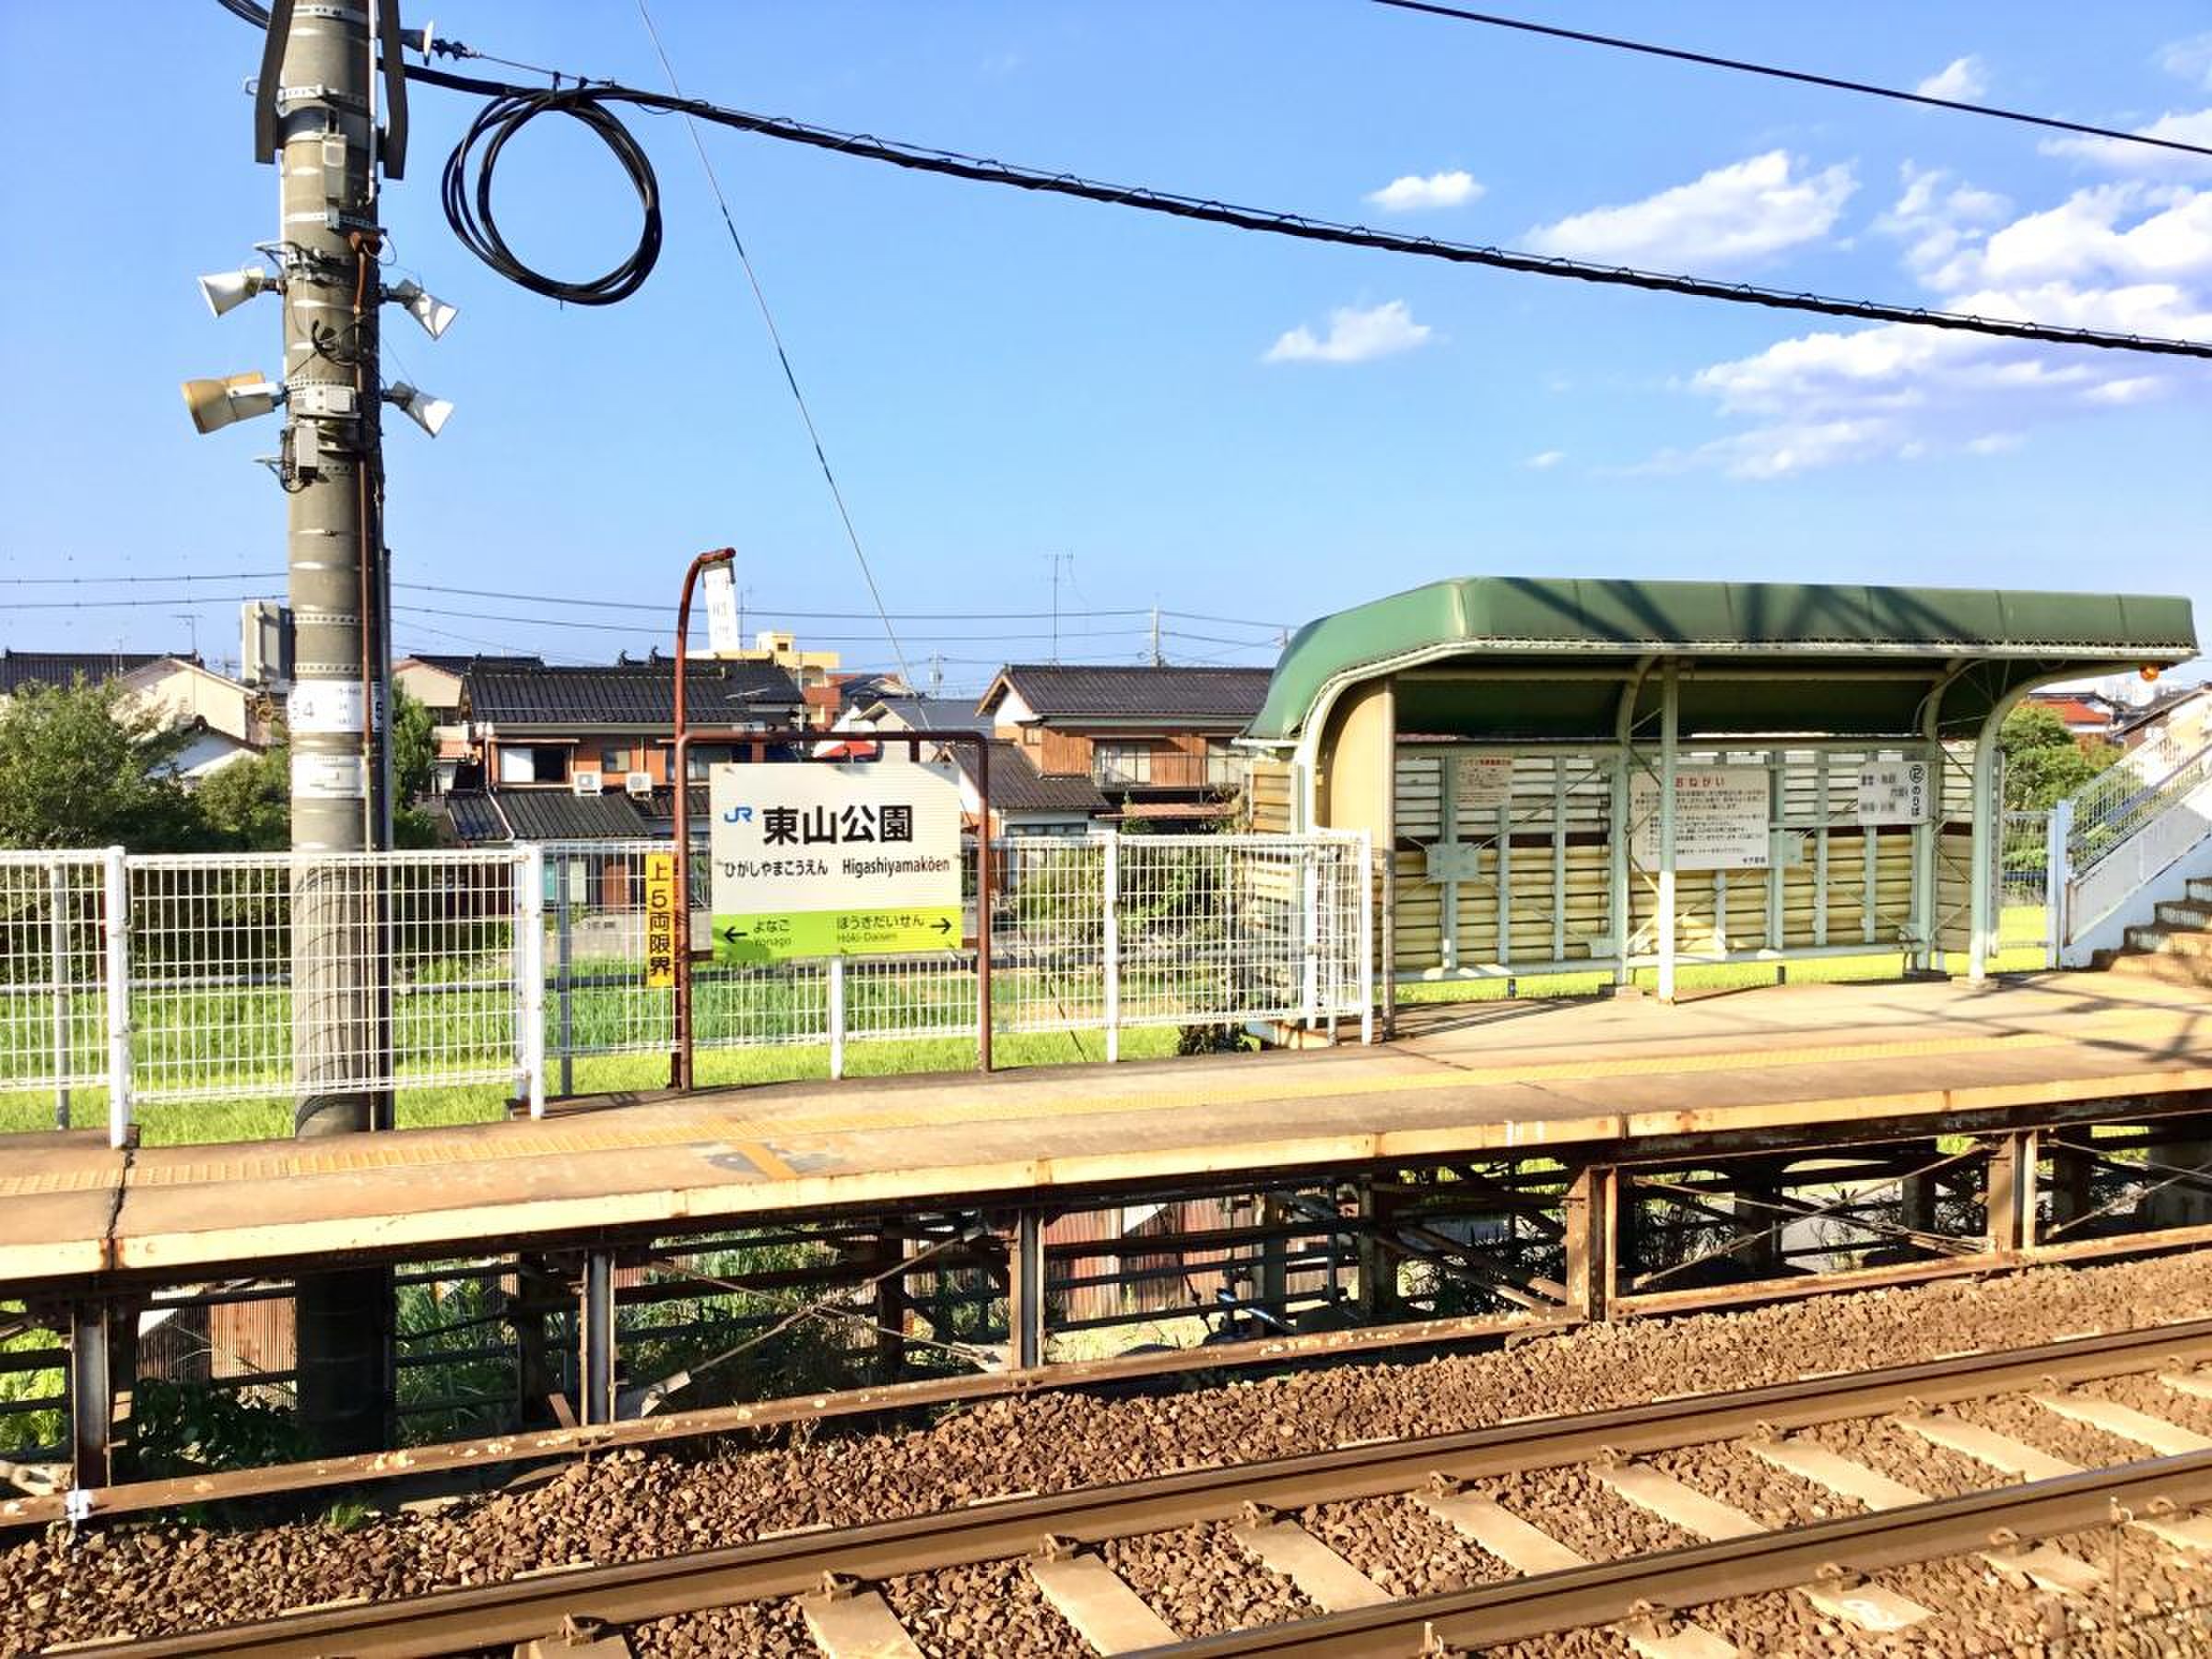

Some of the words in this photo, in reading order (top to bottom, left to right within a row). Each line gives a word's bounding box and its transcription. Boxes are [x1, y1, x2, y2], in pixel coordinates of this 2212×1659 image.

[724, 806, 753, 823] JR
[762, 805, 913, 845] 東山公園
[724, 861, 828, 877] ひがしやまこうえん
[837, 913, 924, 930] ほうきだいせん
